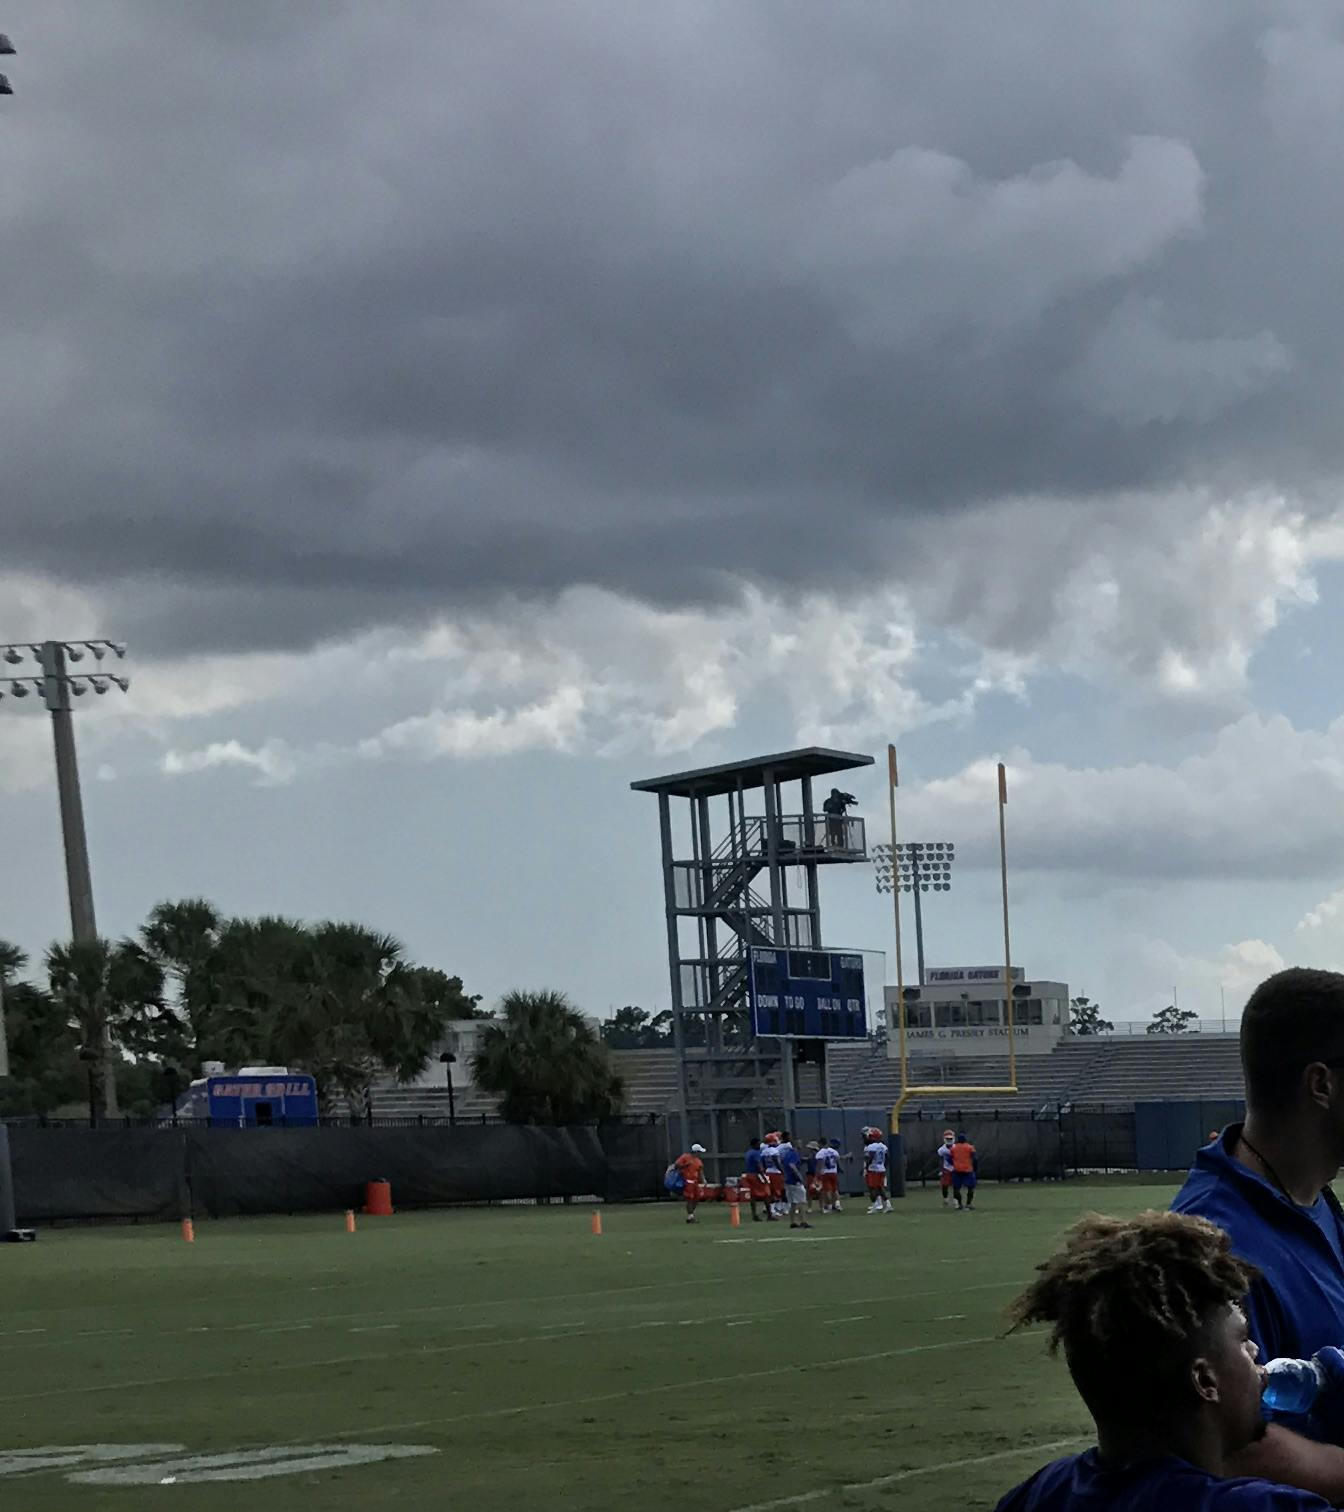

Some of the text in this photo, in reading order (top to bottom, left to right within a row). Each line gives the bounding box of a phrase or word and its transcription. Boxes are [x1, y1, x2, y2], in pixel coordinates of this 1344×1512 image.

[930, 971, 964, 981] FLORIDA
[757, 993, 778, 1009] DOWN
[784, 995, 794, 1009] TO
